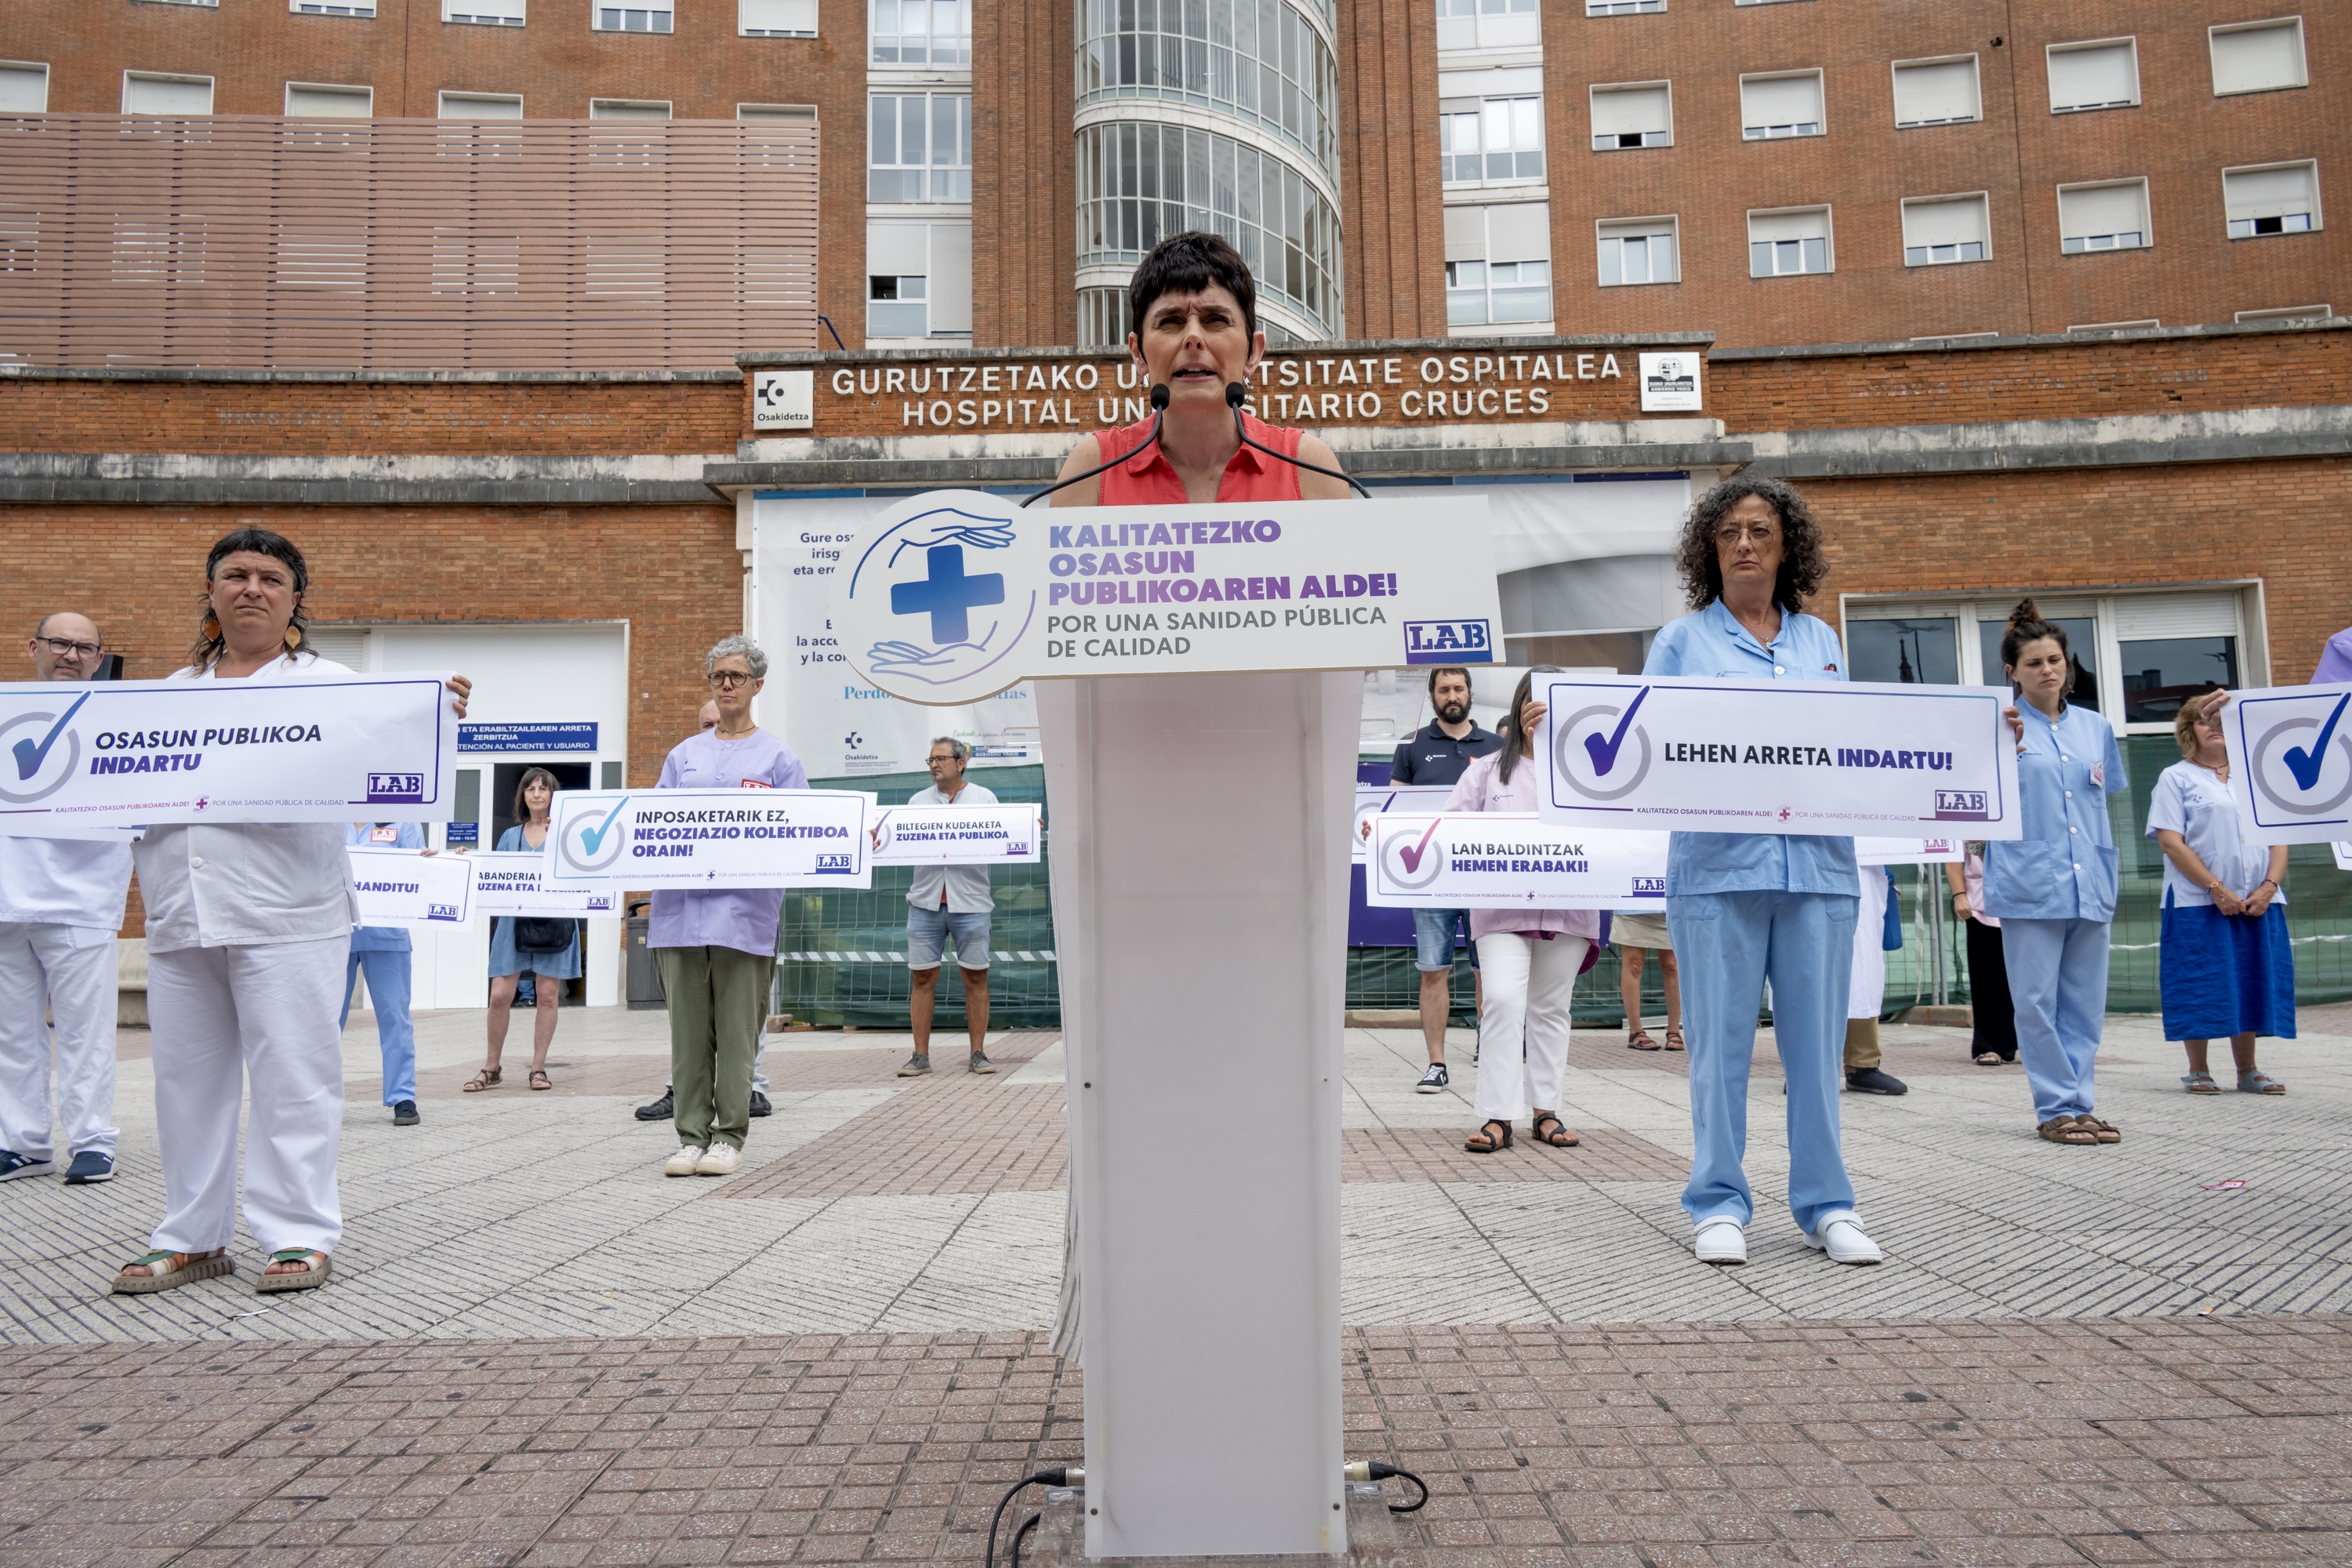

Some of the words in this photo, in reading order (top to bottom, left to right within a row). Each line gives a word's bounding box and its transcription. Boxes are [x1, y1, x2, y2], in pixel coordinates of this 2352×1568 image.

[832, 364, 1098, 394] GURUTZETAKO
[1421, 354, 1621, 383] OSPITALEA
[903, 398, 1080, 426] HOSPITAL
[1400, 388, 1549, 416] CRUCES
[757, 412, 809, 421] Osakidetza
[800, 532, 832, 543] Gure
[1050, 520, 1282, 548] KALITATEZKO
[793, 566, 814, 575] eta
[1049, 550, 1195, 577] OSASUN
[1049, 576, 1291, 606] PUBLIKOAREN
[1299, 572, 1398, 599] ALDE!
[1047, 615, 1098, 633] POR
[1105, 613, 1160, 632] UNA
[1167, 610, 1276, 630] SANIDAD
[1285, 604, 1387, 627] PÚBLICA
[797, 636, 808, 646] la
[1408, 623, 1486, 651] LAB
[1047, 640, 1076, 658] DE
[1084, 637, 1191, 657] CALIDAD
[800, 655, 808, 666] y
[812, 652, 823, 662] la
[95, 729, 198, 750] OSASUN
[202, 724, 322, 746] PUBLIKOA
[1665, 742, 1737, 763] LEHEN
[1743, 745, 1832, 767] ARRETA
[1837, 748, 1953, 771] INDARTU!
[90, 753, 202, 775] INDARTU
[370, 776, 420, 793] LAB
[1937, 793, 1984, 811] LAB
[636, 810, 763, 823] INPOSAKETARIK
[766, 810, 789, 824] EZ,
[633, 826, 741, 840] NEGOZIAZIO
[744, 826, 849, 839] KOLEKTIBOA
[896, 822, 943, 831] BILTEGIEN
[945, 821, 1002, 829] KUDEAKETA
[896, 833, 937, 841] ZUZENA
[938, 832, 956, 840] ETA
[959, 831, 1010, 840] PUBLIKOA
[632, 844, 694, 858] ORAIN!
[1451, 844, 1482, 855] LAN
[1486, 844, 1585, 856] BALDINTZAK
[1925, 840, 1947, 848] LAB
[818, 856, 850, 867] LAB
[1451, 859, 1508, 872] HEMEN
[1511, 860, 1588, 873] ERABAKI!
[479, 872, 535, 880] ABANDERIA
[477, 883, 513, 891] UZENA
[515, 884, 535, 892] ETA
[1634, 879, 1665, 891] LAB
[430, 906, 456, 916] LAB
